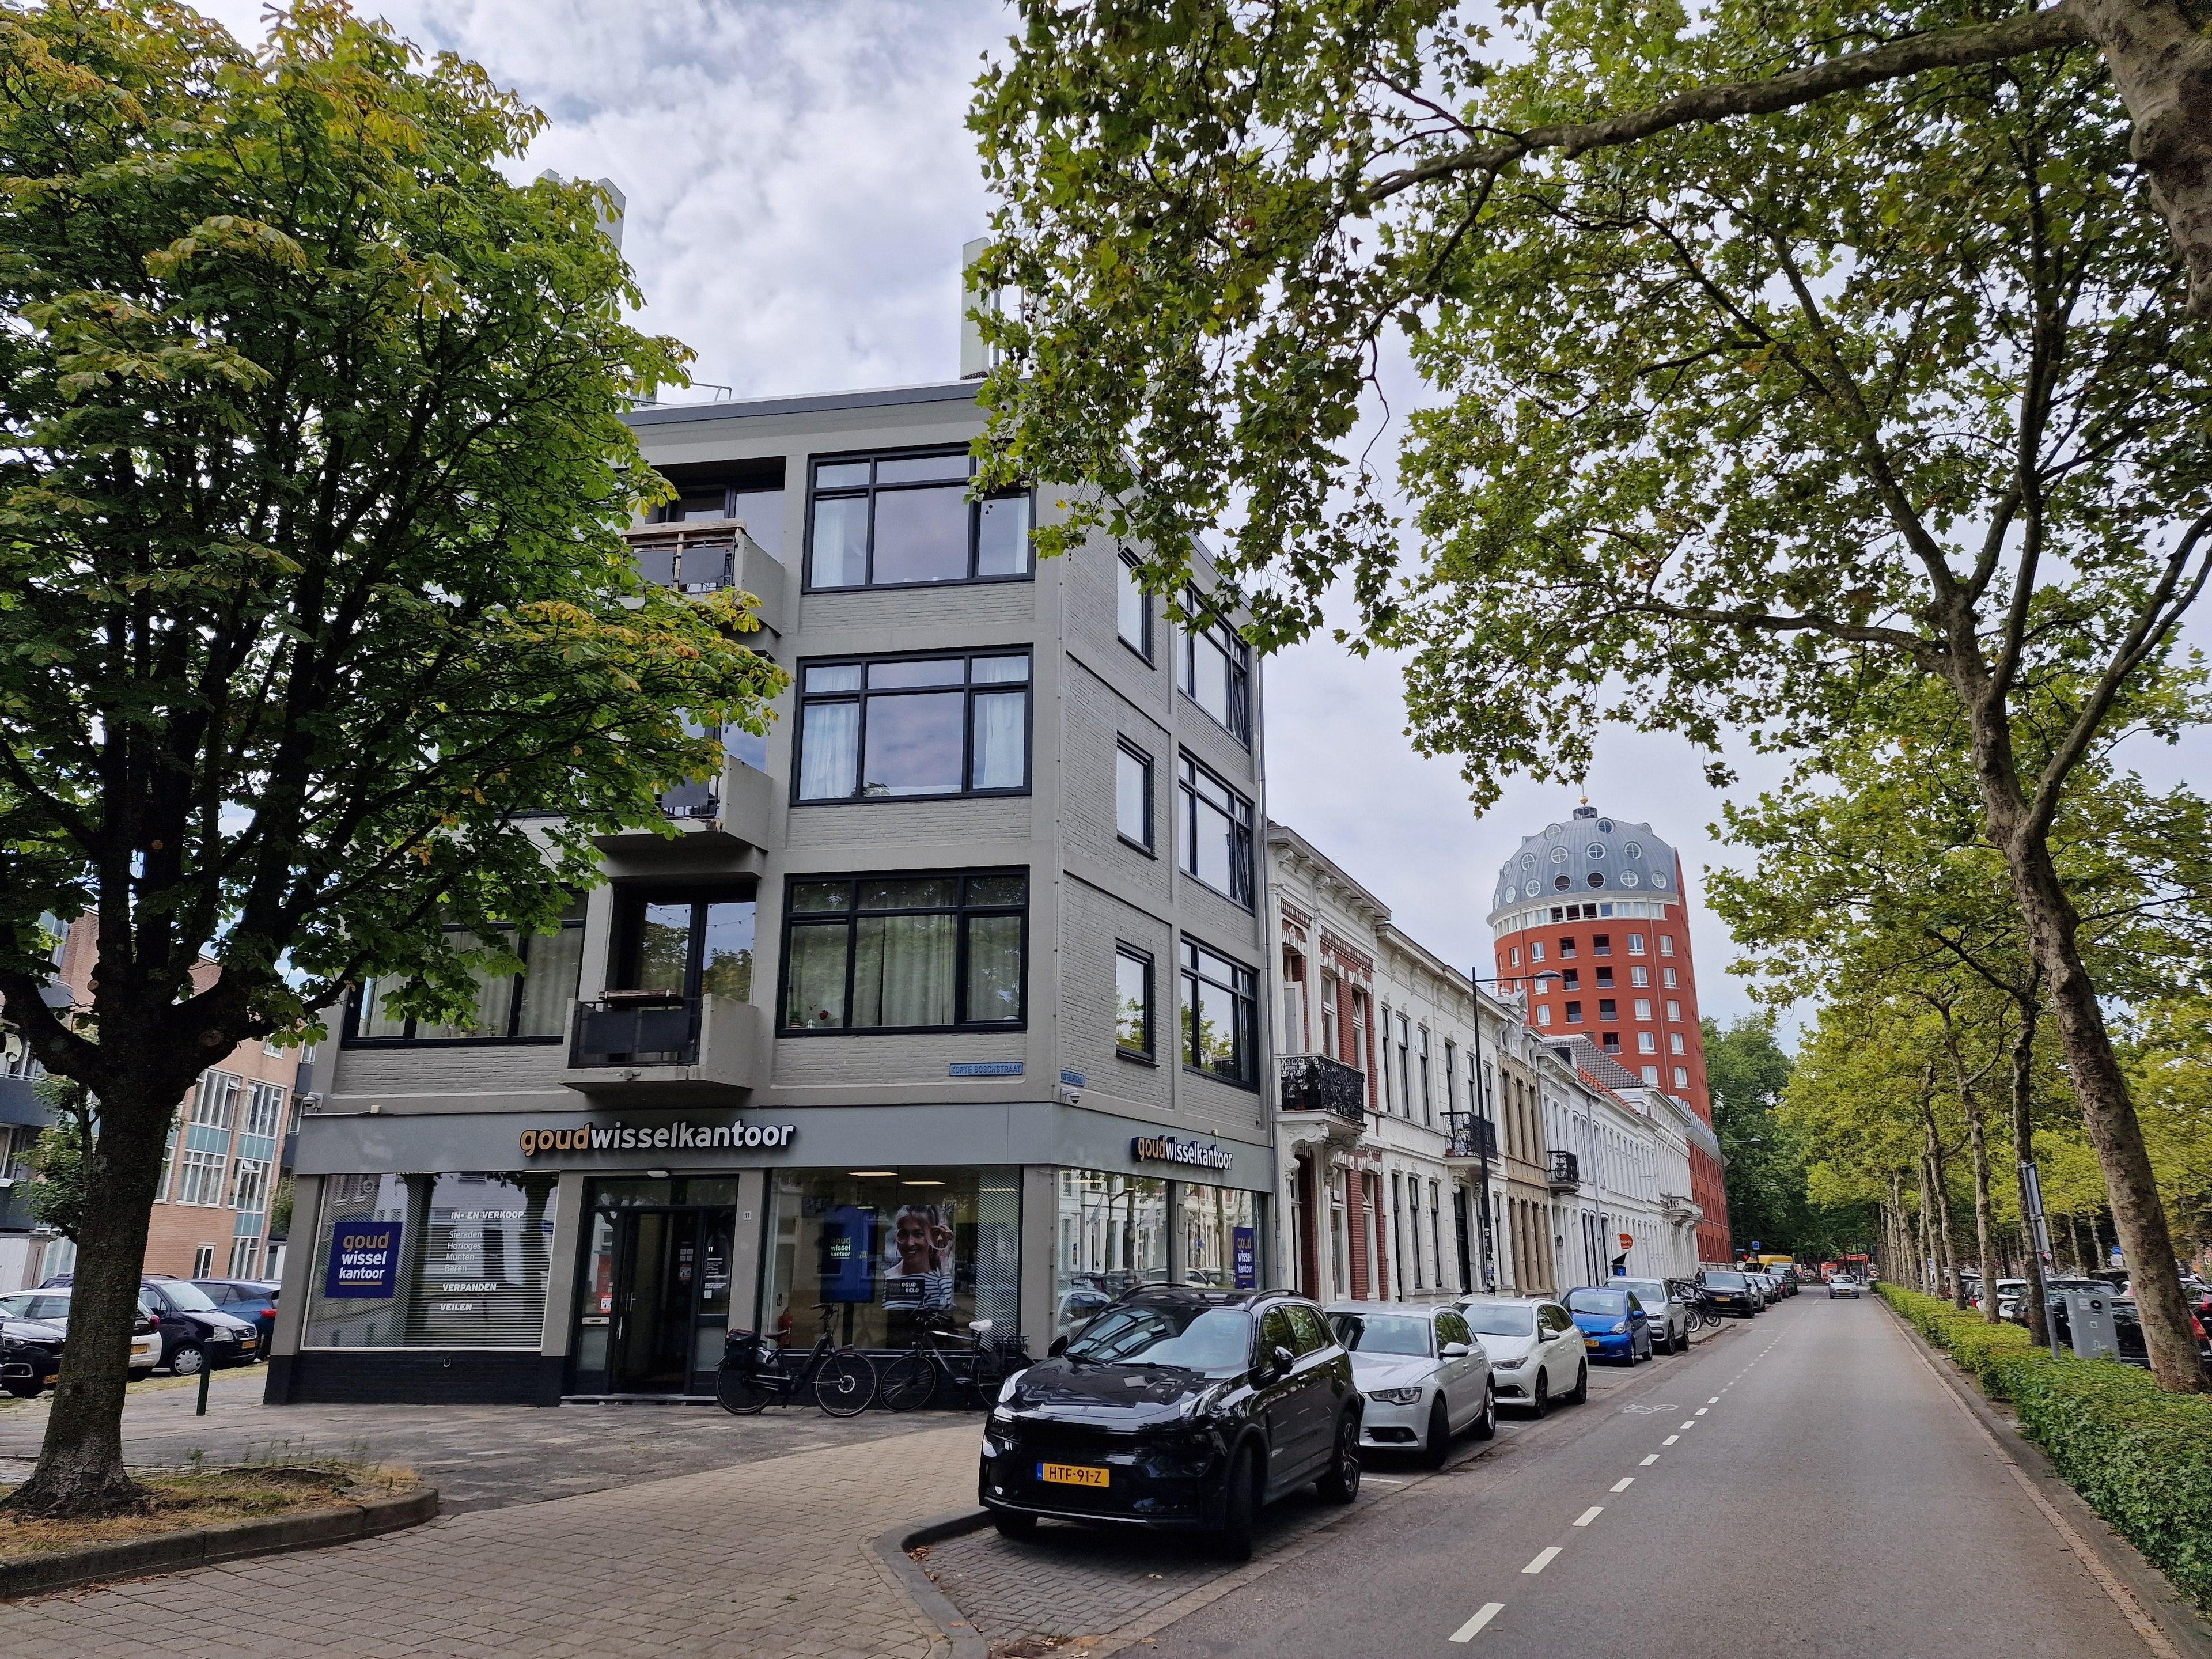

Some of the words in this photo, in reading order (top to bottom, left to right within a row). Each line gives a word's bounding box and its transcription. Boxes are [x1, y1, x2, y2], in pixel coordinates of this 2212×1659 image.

[950, 1066, 972, 1074] KORTE
[974, 1065, 1022, 1074] BOSCHSTRAAT
[520, 1120, 795, 1157] goudwisselkantoor
[1138, 1135, 1233, 1170] goudwisselkantoor
[451, 1211, 465, 1219] IN-
[467, 1211, 480, 1219] EN
[482, 1211, 524, 1219] VERKOOP
[448, 1230, 482, 1238] Sieraden
[343, 1230, 390, 1253] goud
[831, 1236, 851, 1245] goud
[1237, 1235, 1251, 1252] goud
[447, 1242, 482, 1251] Horloges
[342, 1250, 388, 1265] wissel
[445, 1253, 475, 1261] Munten
[1238, 1249, 1252, 1262] wissel
[444, 1264, 467, 1272] Baren
[339, 1267, 386, 1279] kantoor
[442, 1283, 497, 1291] VERPANDEN
[440, 1303, 473, 1311] VEILEN
[1049, 1466, 1102, 1484] HTF-91-Z
